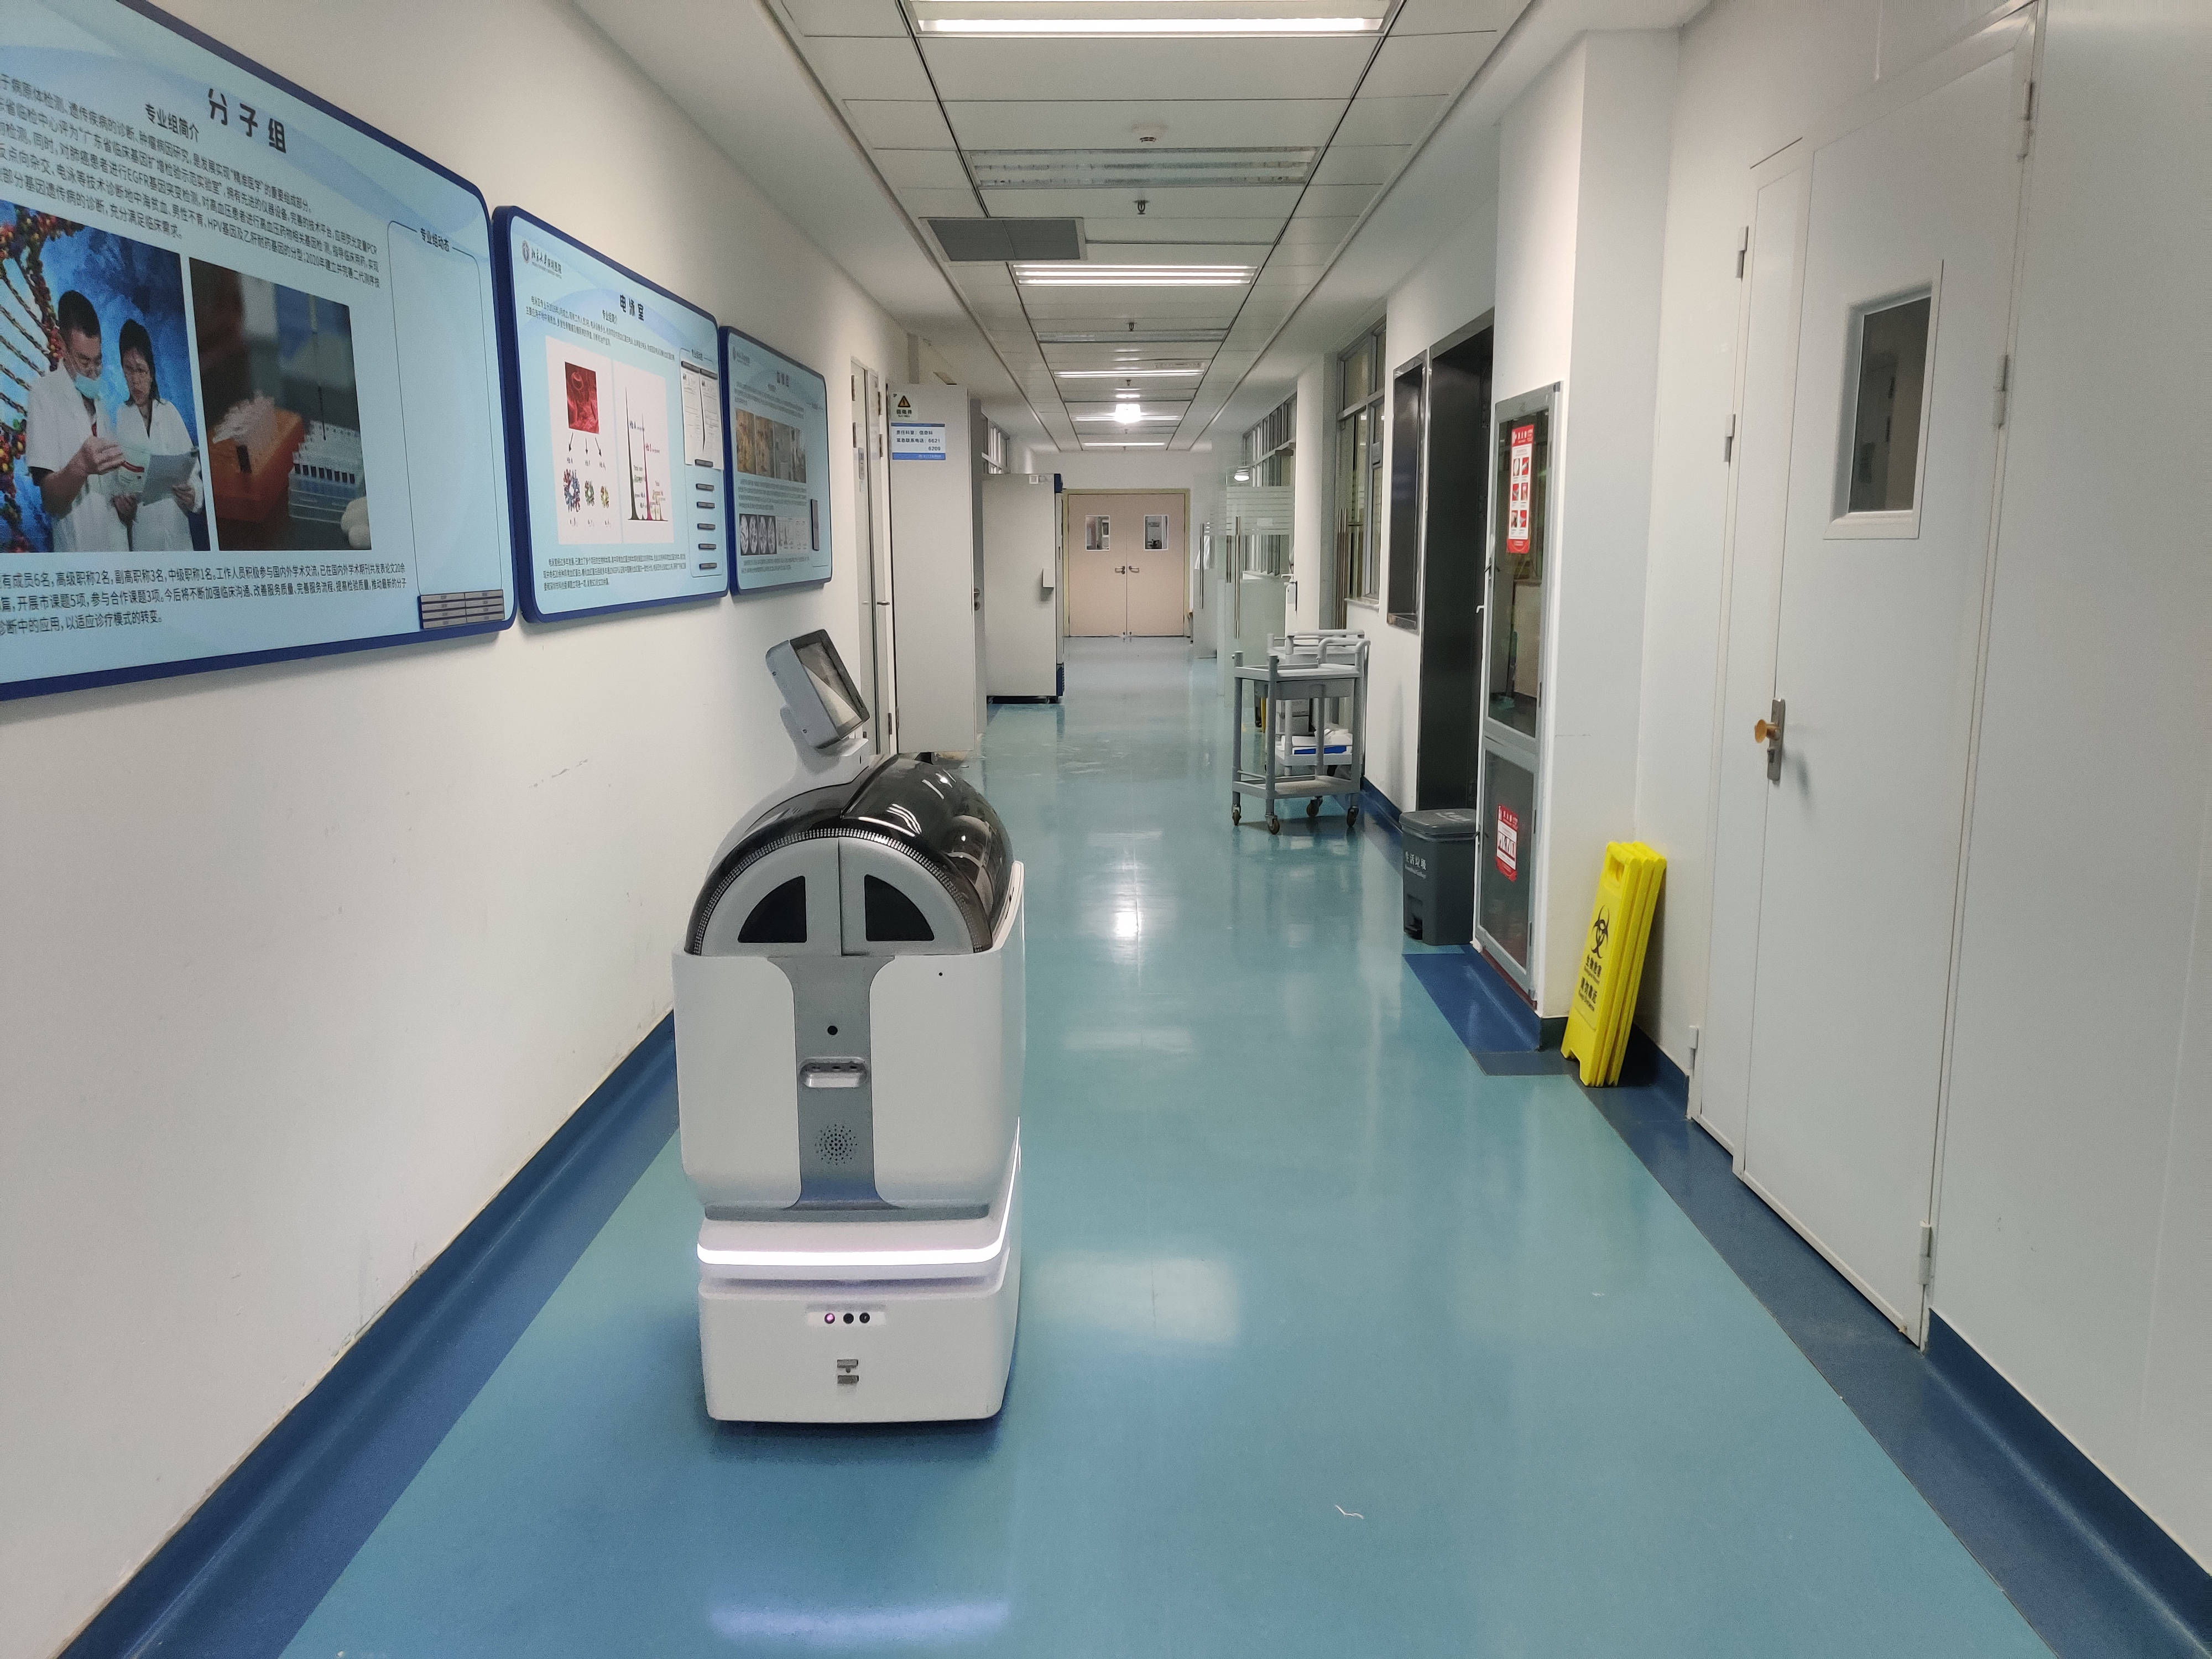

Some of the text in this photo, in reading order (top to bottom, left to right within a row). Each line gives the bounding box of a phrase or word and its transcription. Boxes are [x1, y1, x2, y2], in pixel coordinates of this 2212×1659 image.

[145, 102, 199, 143] 专业组简介
[208, 88, 286, 154] 分子组
[619, 294, 644, 321] 电泳室
